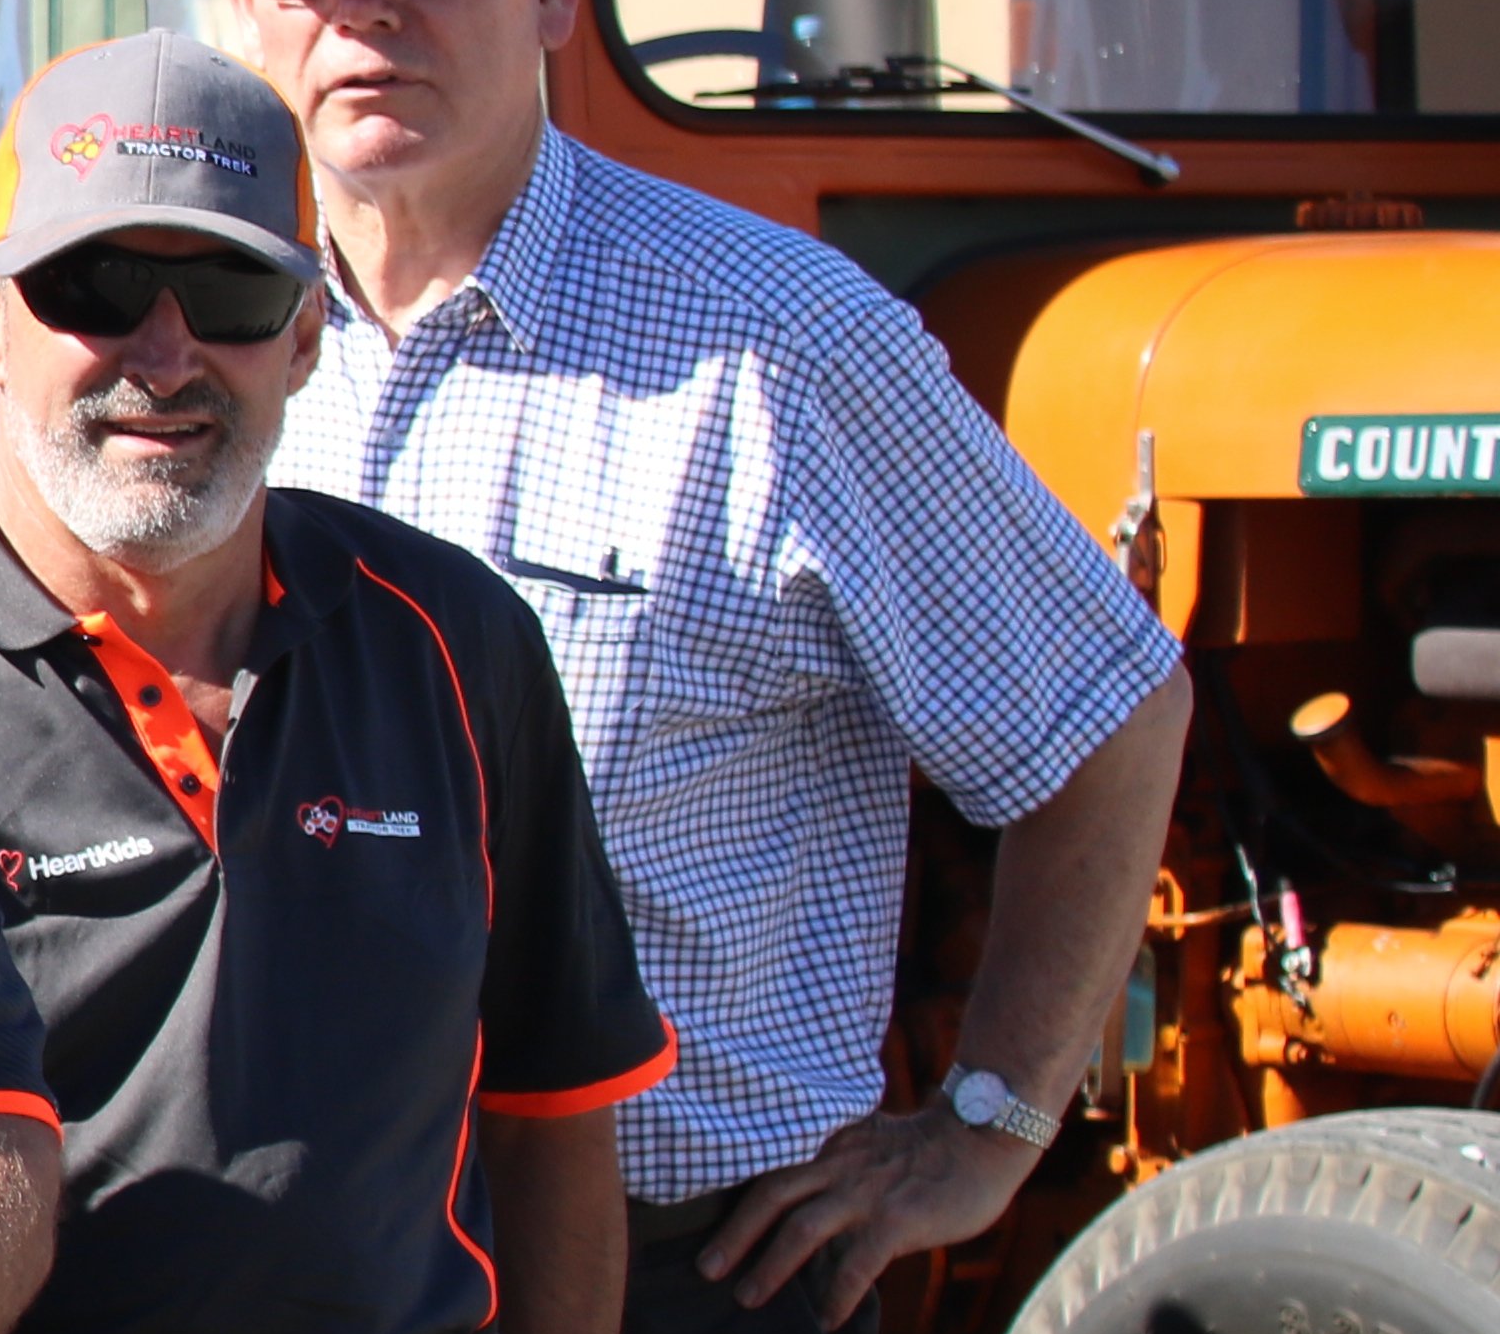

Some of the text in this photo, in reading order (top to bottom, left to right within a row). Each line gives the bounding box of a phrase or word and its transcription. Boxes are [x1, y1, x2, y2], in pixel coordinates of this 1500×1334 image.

[112, 123, 257, 160] HEARTLAND
[123, 142, 252, 176] TRACTOR TREK
[1315, 424, 1500, 482] COUNT
[28, 836, 155, 881] HeartKids
